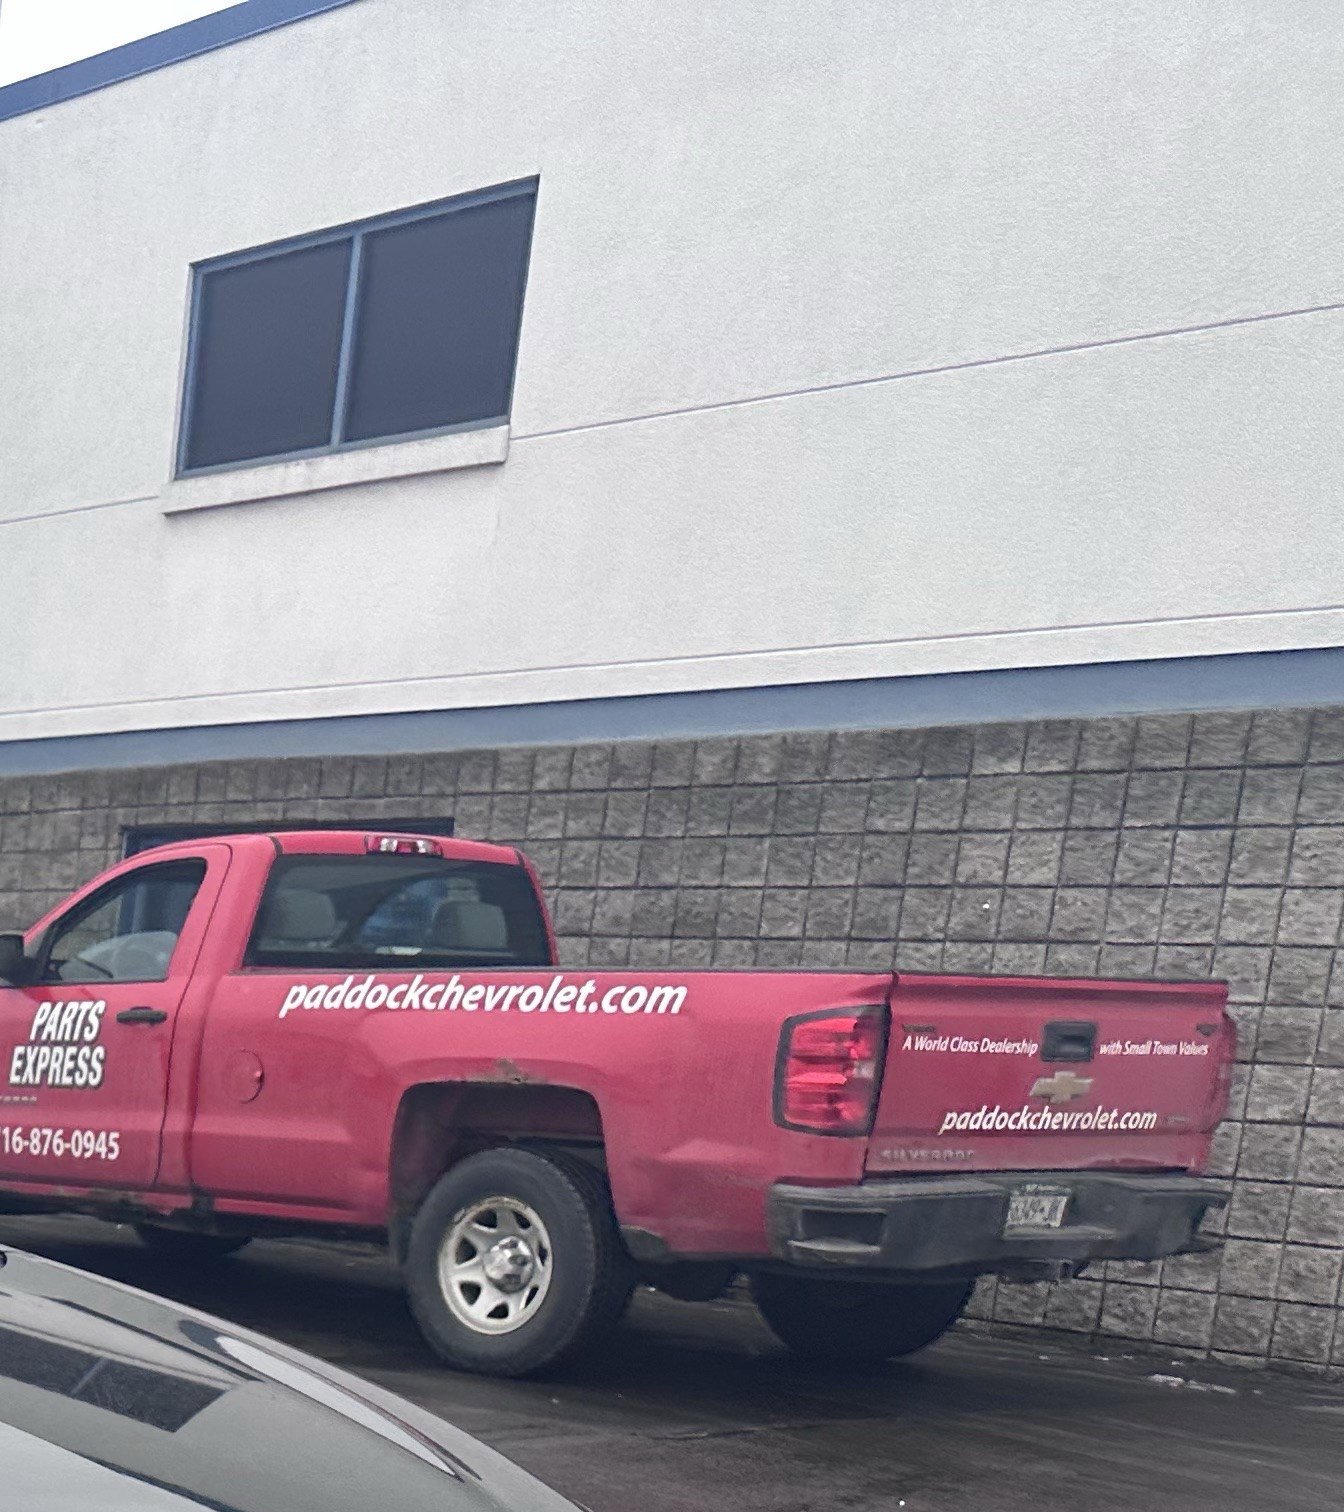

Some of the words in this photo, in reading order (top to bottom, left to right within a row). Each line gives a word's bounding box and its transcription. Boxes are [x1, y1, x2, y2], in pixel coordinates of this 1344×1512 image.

[278, 975, 688, 1018] paddockchevrolet.com
[29, 1000, 105, 1042] PARTS
[9, 1046, 105, 1086] EXPRESS
[902, 1035, 912, 1050] A
[914, 1036, 949, 1051] World
[950, 1036, 979, 1052] Class
[980, 1037, 1038, 1057] Dealership
[1100, 1041, 1122, 1055] with
[1123, 1040, 1152, 1055] Small
[1153, 1041, 1177, 1055] Town
[1179, 1041, 1209, 1055] Values
[937, 1105, 1157, 1136] paddockchevrolet.com
